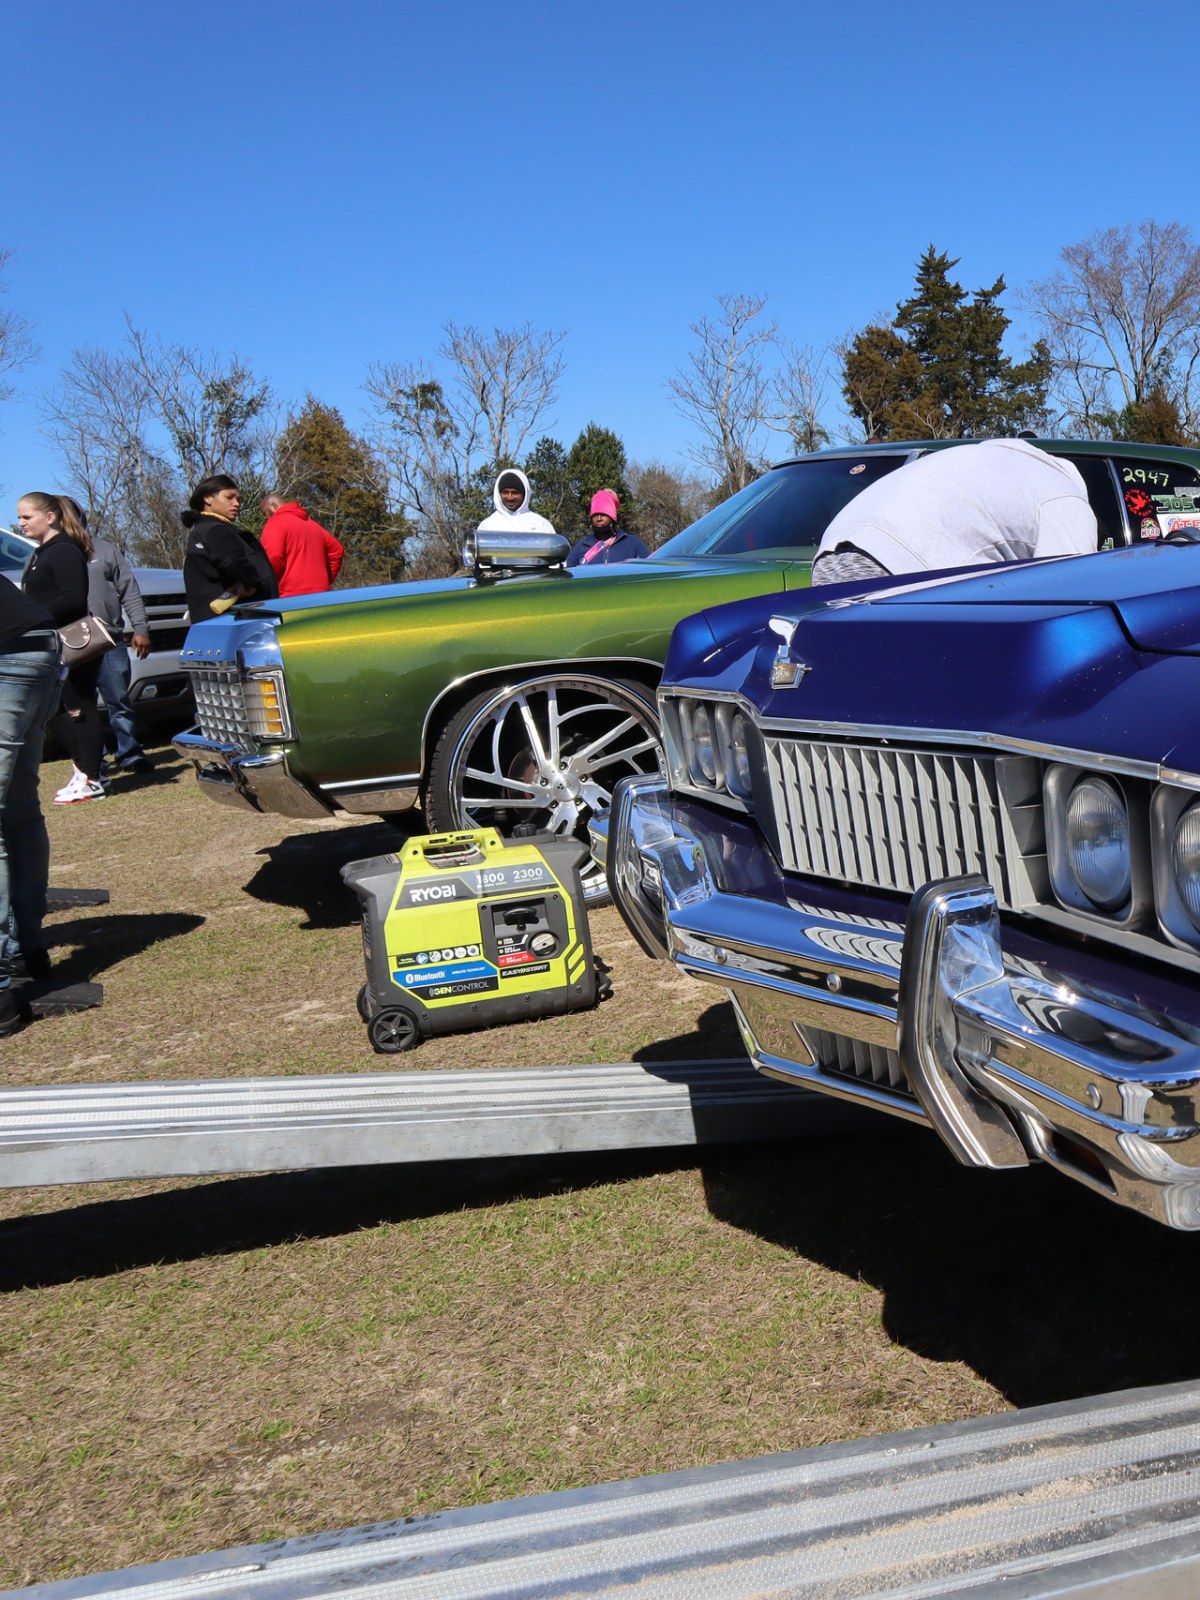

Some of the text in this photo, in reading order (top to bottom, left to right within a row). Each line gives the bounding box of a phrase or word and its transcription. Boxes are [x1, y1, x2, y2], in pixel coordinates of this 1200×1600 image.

[1122, 467, 1169, 487] 2947
[513, 867, 543, 880] 2300
[409, 884, 457, 902] RYOBI
[414, 970, 445, 982] Bluetooth
